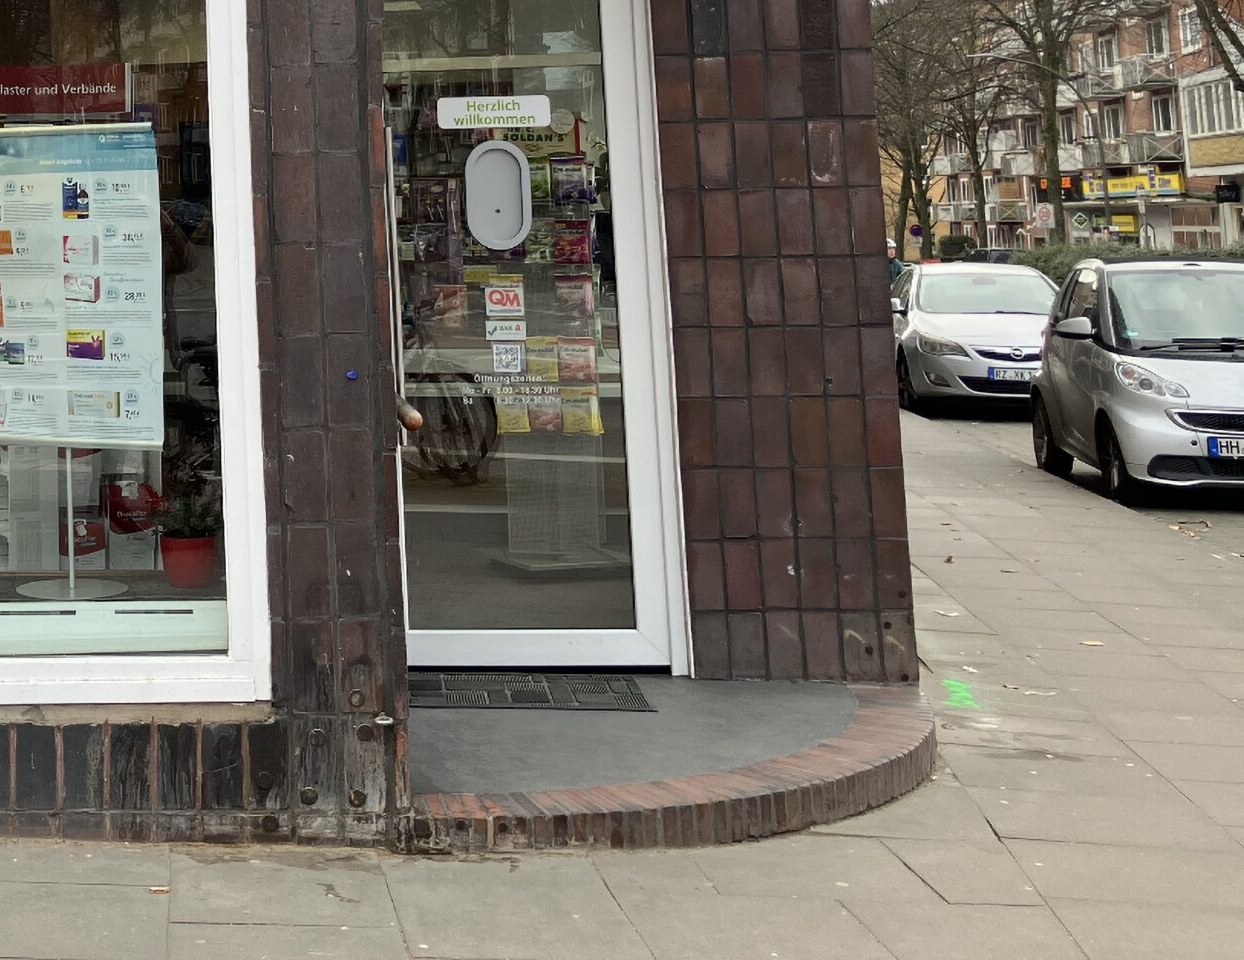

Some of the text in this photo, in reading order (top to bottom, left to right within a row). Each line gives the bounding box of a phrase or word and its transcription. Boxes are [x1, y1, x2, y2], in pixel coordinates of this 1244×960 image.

[34, 84, 58, 95] und
[61, 82, 117, 94] Verbände
[466, 100, 521, 112] Herzlich
[453, 114, 536, 127] willkommen
[488, 289, 522, 307] QM
[543, 385, 560, 394] Uhr
[1219, 440, 1241, 455] HH
